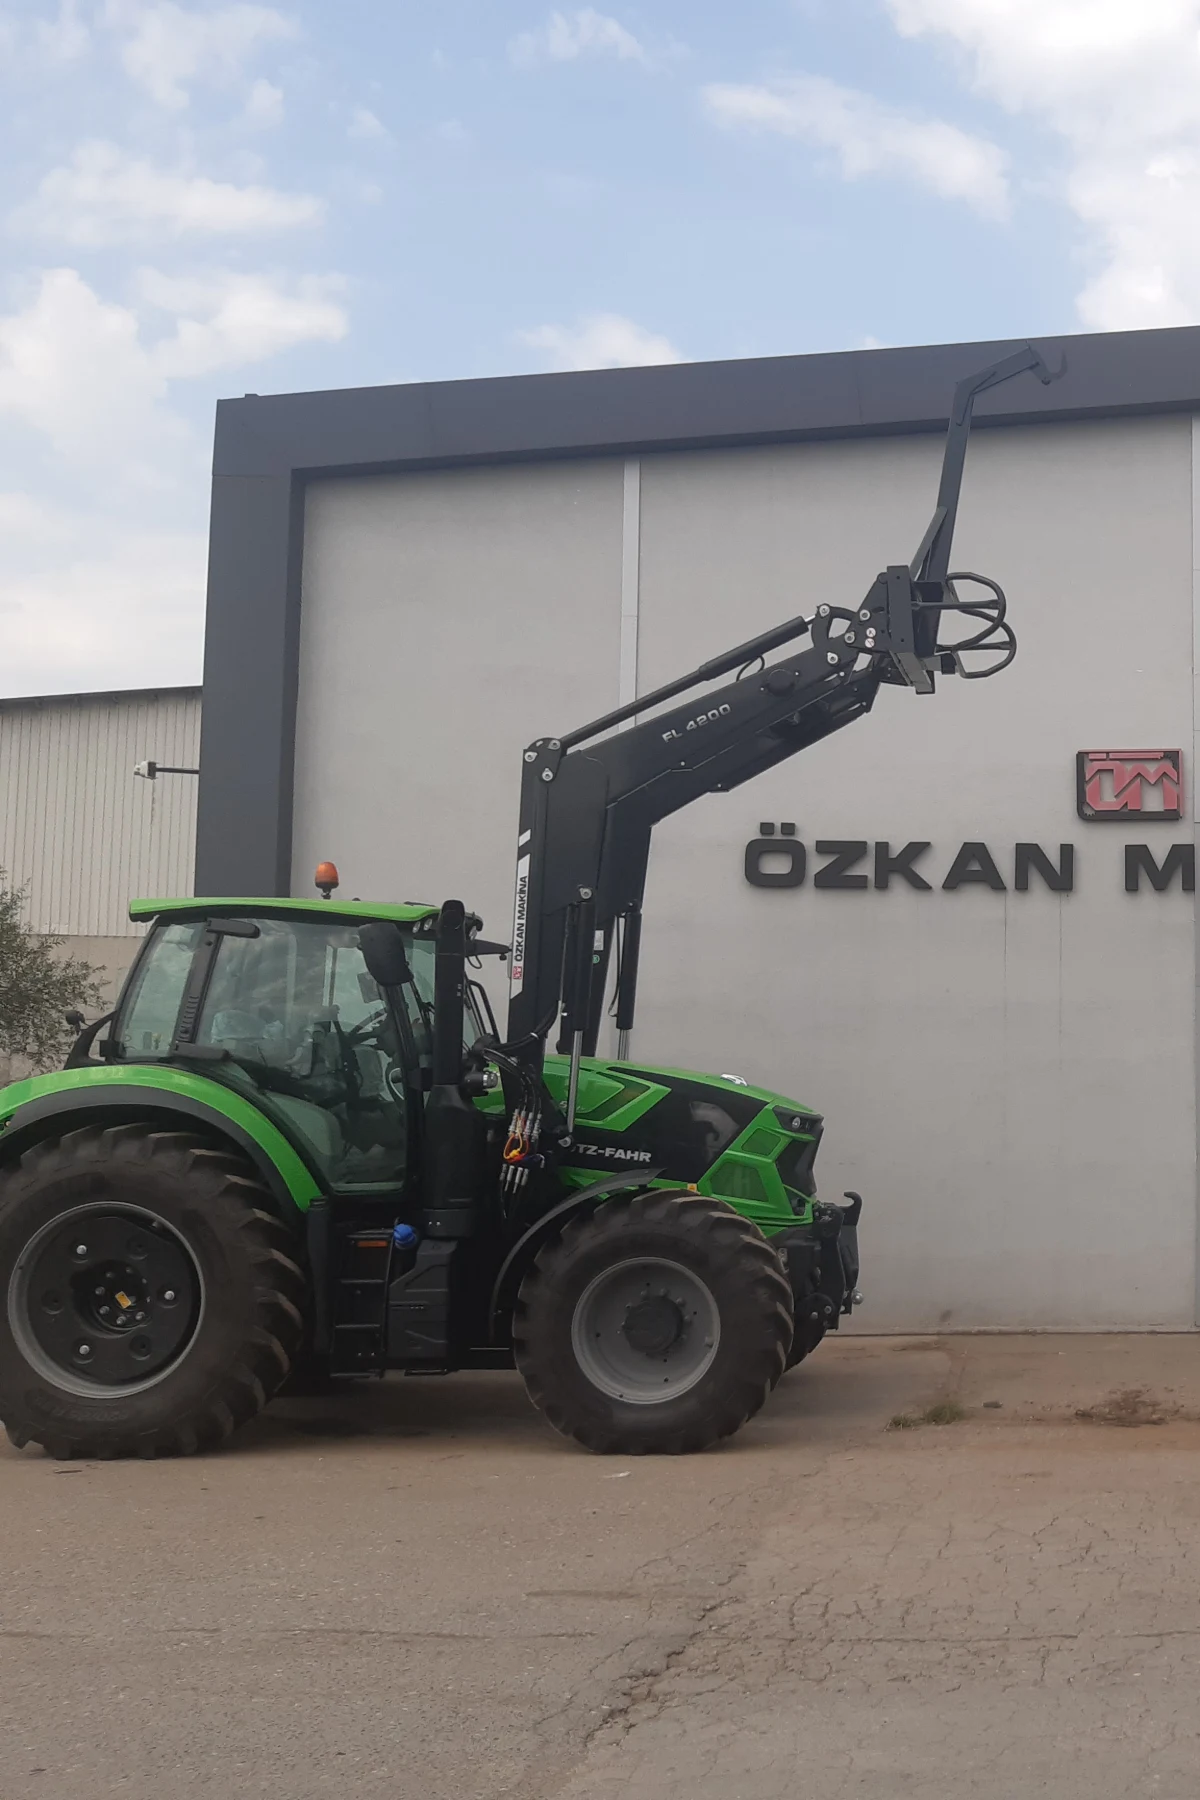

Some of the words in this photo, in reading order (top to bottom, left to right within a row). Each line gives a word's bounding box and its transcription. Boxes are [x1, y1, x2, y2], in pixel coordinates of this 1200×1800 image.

[661, 729, 683, 743] FL
[686, 703, 731, 731] 4200
[744, 821, 1074, 893] ÖZKAN
[517, 875, 528, 920] MAKİNA
[514, 922, 525, 962] ÖZKAN
[571, 1143, 652, 1162] TZ-FAHR
